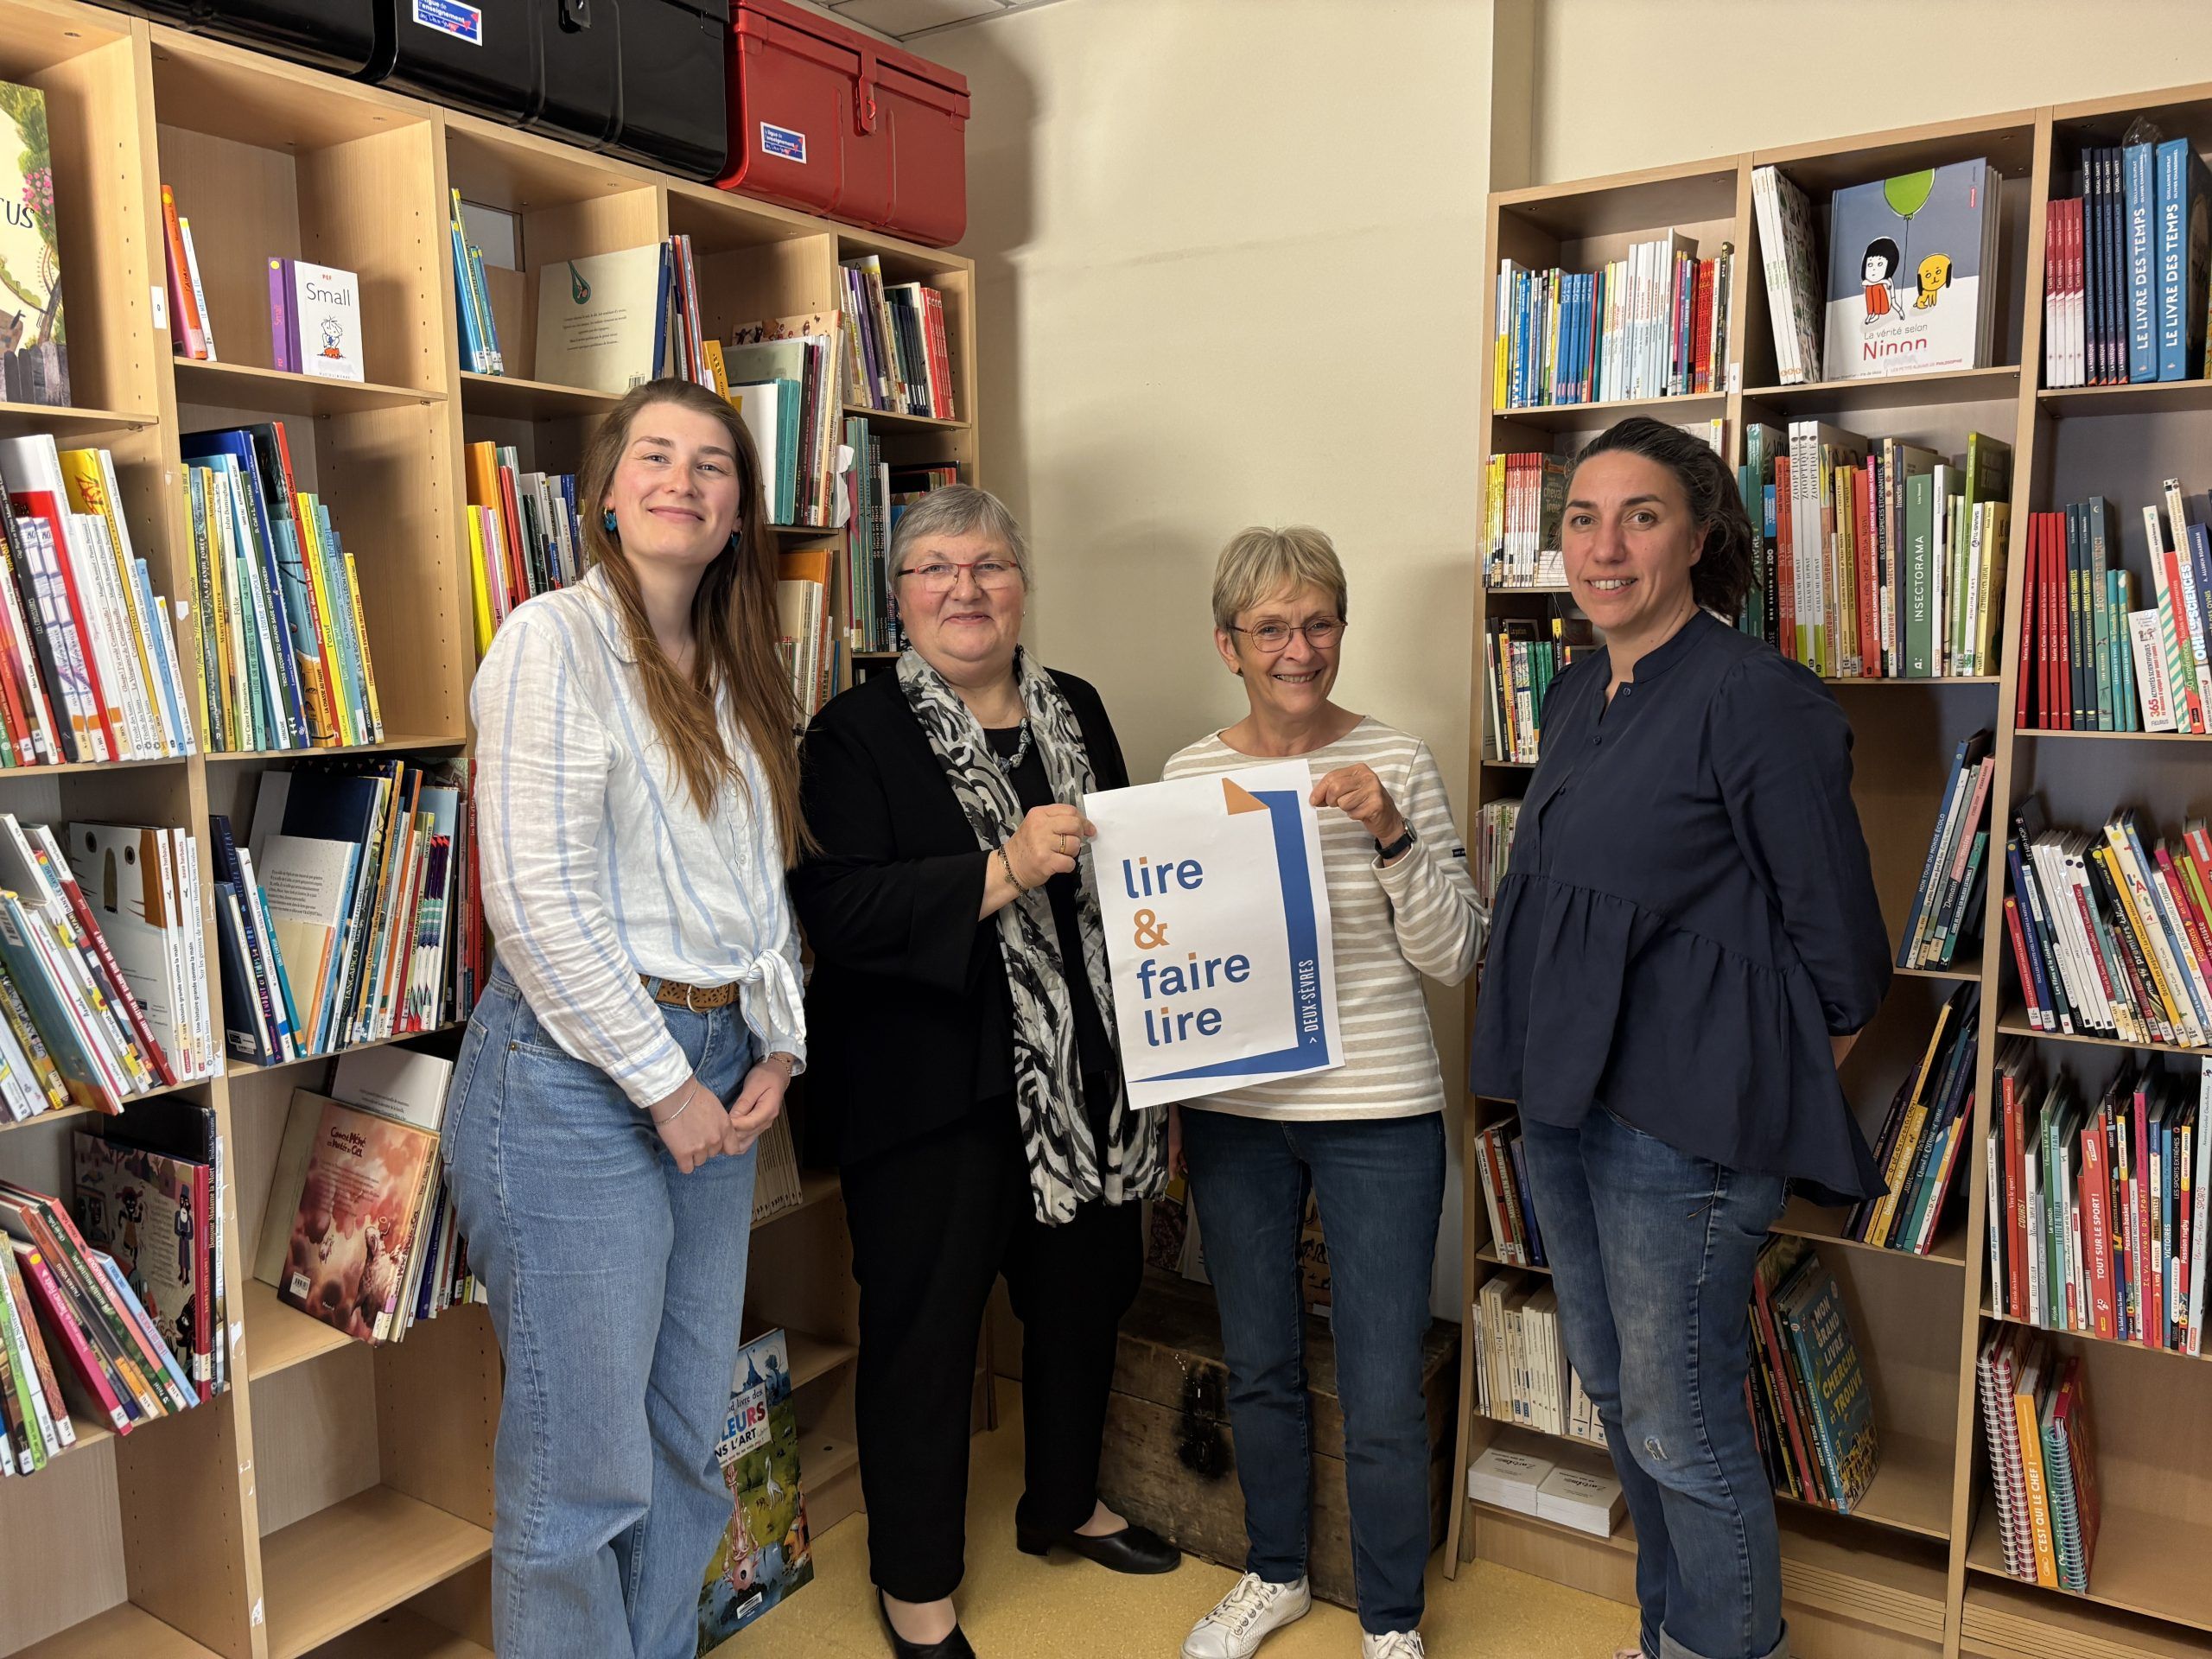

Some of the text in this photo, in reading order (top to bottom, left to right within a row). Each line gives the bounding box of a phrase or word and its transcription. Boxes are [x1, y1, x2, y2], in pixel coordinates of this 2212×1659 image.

[0, 198, 35, 228] US
[2134, 208, 2148, 349] LE LIVRE DES TEMPS
[2165, 203, 2177, 346] LE LIVRE DES TEMPS
[306, 283, 351, 307] Small
[1877, 327, 1902, 338] vérité
[1905, 324, 1928, 334] selon
[1864, 338, 1927, 361] Ninon
[1915, 535, 1923, 621] INSECTORAMA
[2148, 698, 2159, 717] 365
[1123, 856, 1204, 899] lire
[1134, 908, 1170, 950] &
[1137, 951, 1250, 1000] faire
[1297, 959, 1319, 1033] DEUX-SÈVRES
[1144, 1007, 1223, 1046] lire
[2092, 1198, 2101, 1224] SPORT
[2094, 1226, 2102, 1236] LE
[2122, 1226, 2131, 1250] Passion
[2094, 1238, 2103, 1255] SUR
[2180, 1241, 2189, 1263] Passion
[2095, 1257, 2105, 1279] TOUT
[1814, 1295, 1831, 1324] MON
[1823, 1332, 1845, 1367] LIVRE
[1822, 1344, 1857, 1400] CHERCHE
[737, 1389, 763, 1408] livre des
[1834, 1367, 1863, 1417] TROUVE
[731, 1428, 756, 1451] L'ART
[2029, 1467, 2049, 1553] C'EST QUI LE CHEF
